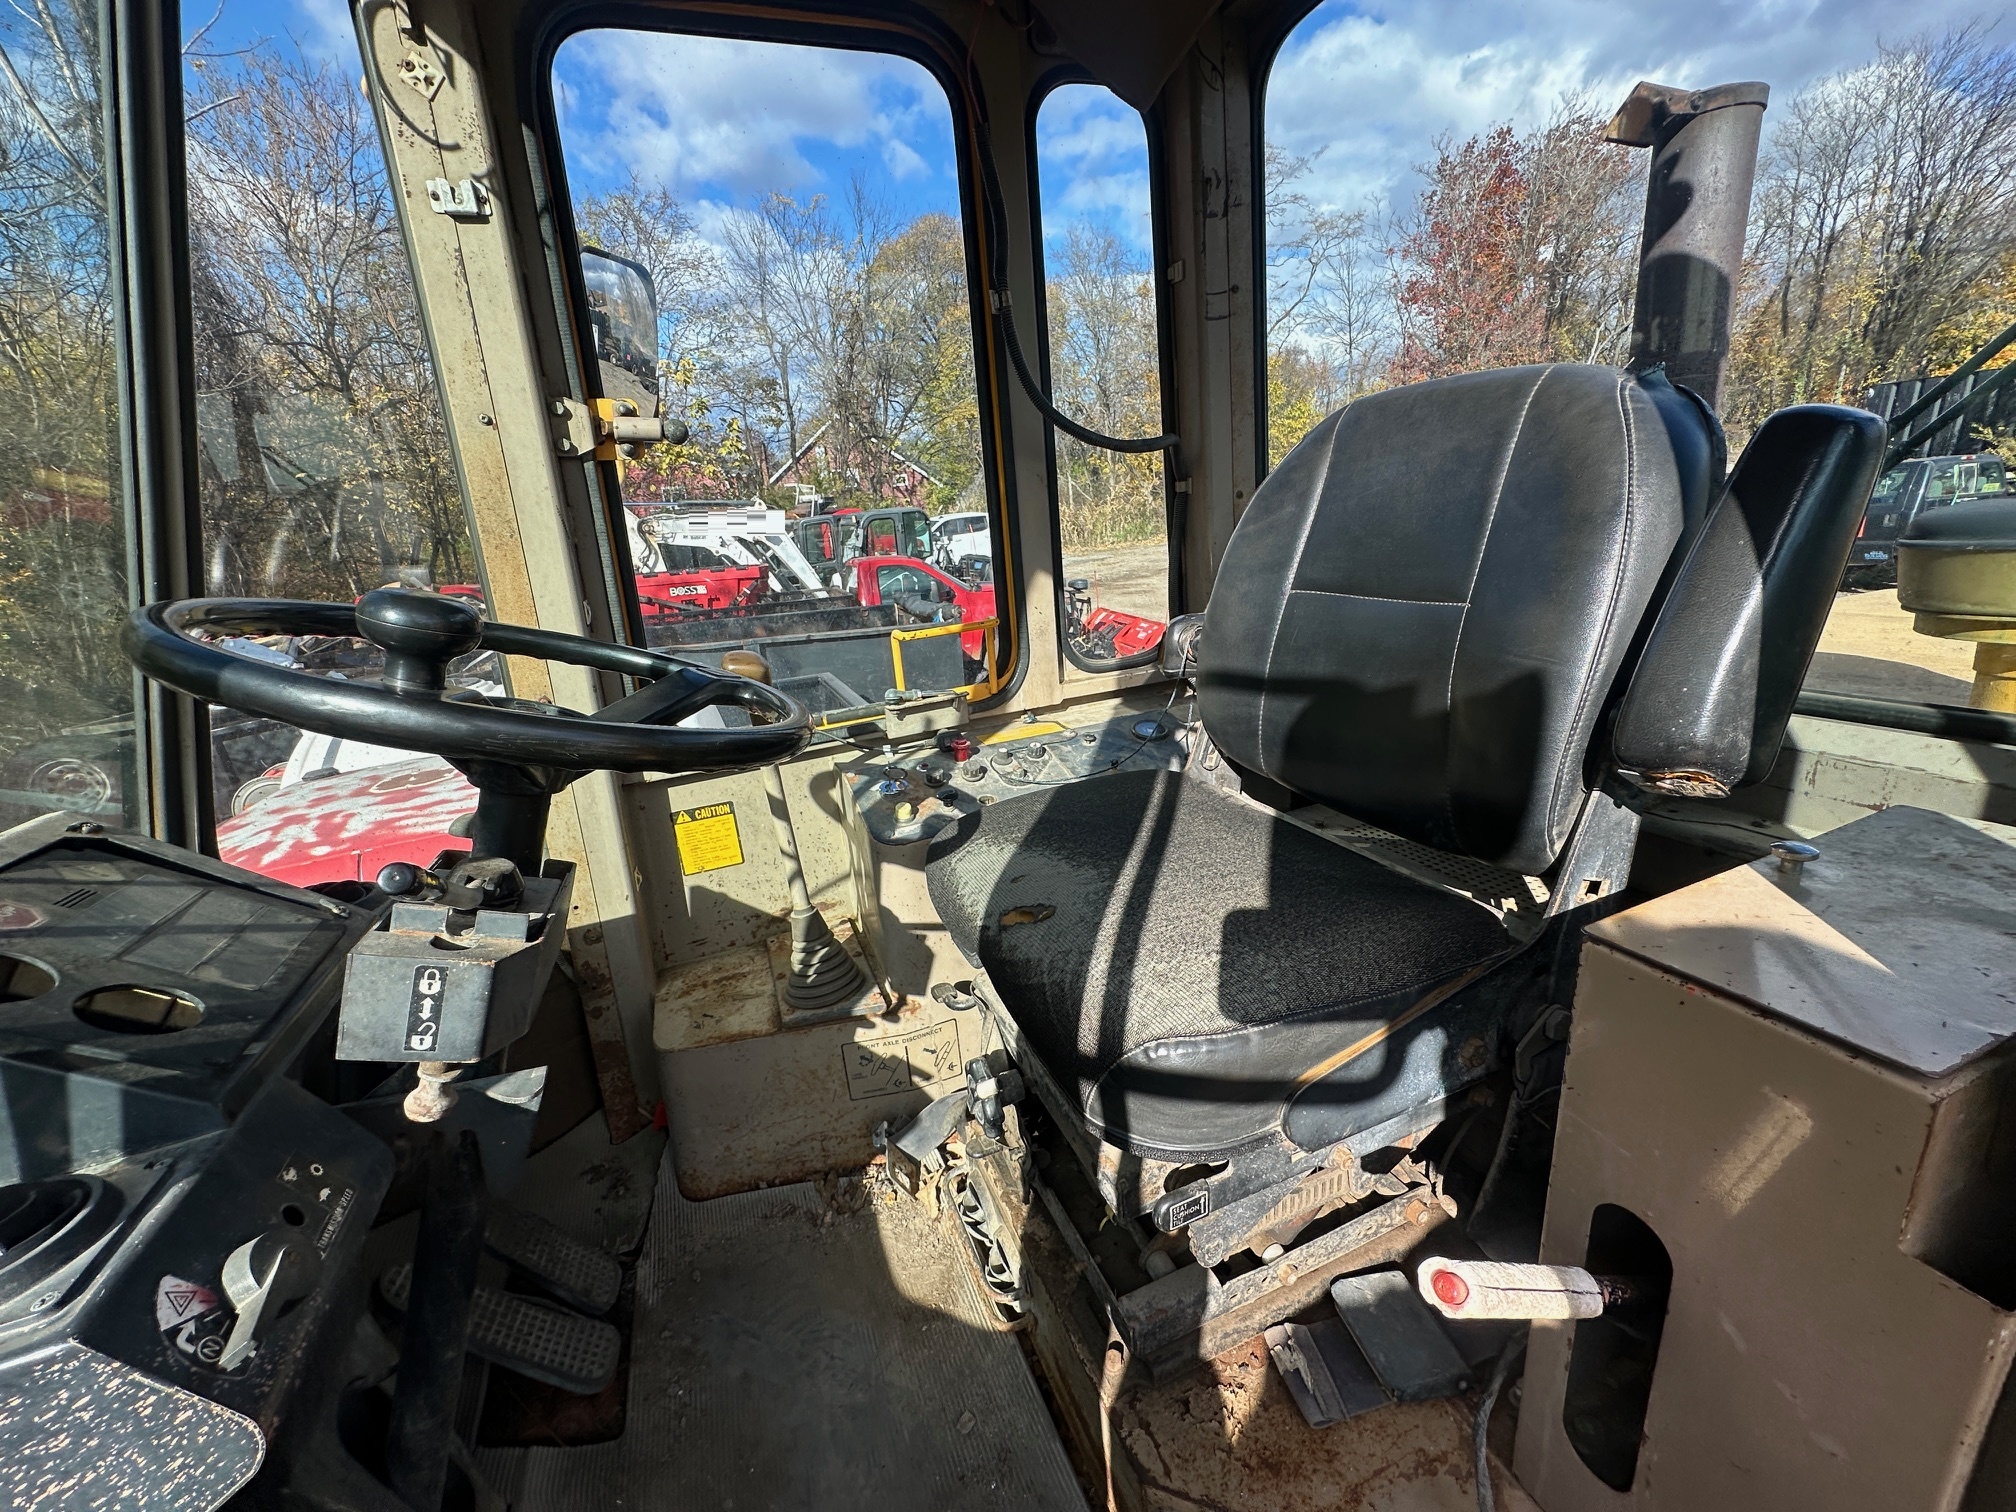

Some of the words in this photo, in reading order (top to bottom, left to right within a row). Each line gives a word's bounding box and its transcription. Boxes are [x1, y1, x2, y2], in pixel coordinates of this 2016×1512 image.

[669, 585, 698, 598] BOSS
[694, 803, 731, 820] CAUTION
[857, 1042, 880, 1051] FRONT
[882, 1039, 900, 1047] AXLE
[901, 1027, 943, 1044] DISCONNECT
[1173, 1203, 1188, 1215] SEAT
[1173, 1203, 1200, 1221] CUSHION
[316, 1206, 345, 1249] TRANSMISSION
[339, 1188, 354, 1207] SPEED
[1173, 1217, 1184, 1227] TILT
